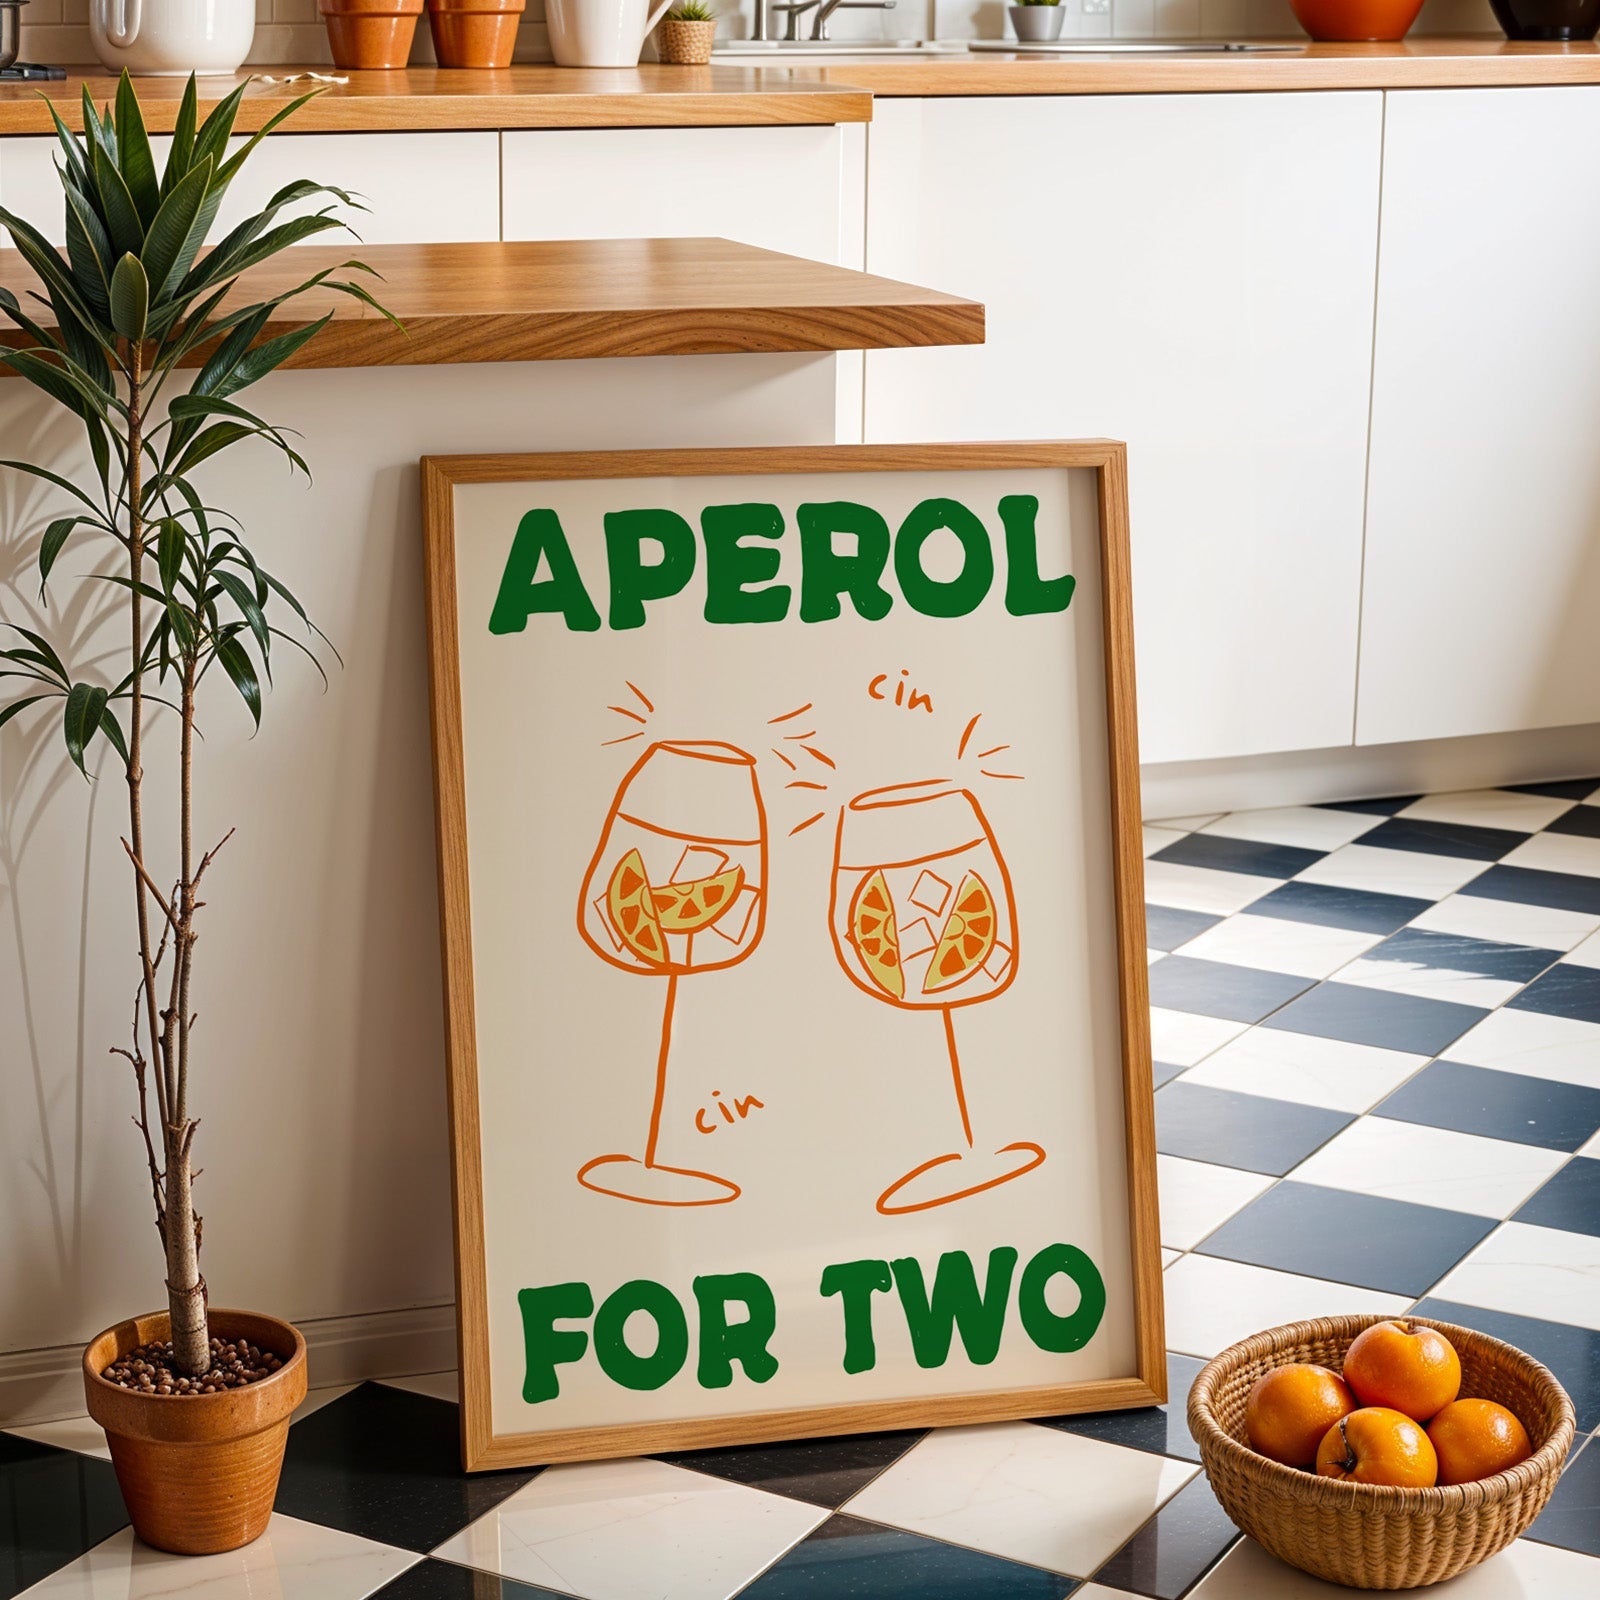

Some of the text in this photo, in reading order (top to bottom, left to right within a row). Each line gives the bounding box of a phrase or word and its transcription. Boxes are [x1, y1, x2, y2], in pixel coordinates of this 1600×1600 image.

[488, 494, 1076, 635] APEROL
[867, 669, 934, 714] cin
[694, 1090, 765, 1135] cin
[517, 1243, 1106, 1404] FOR TWO
